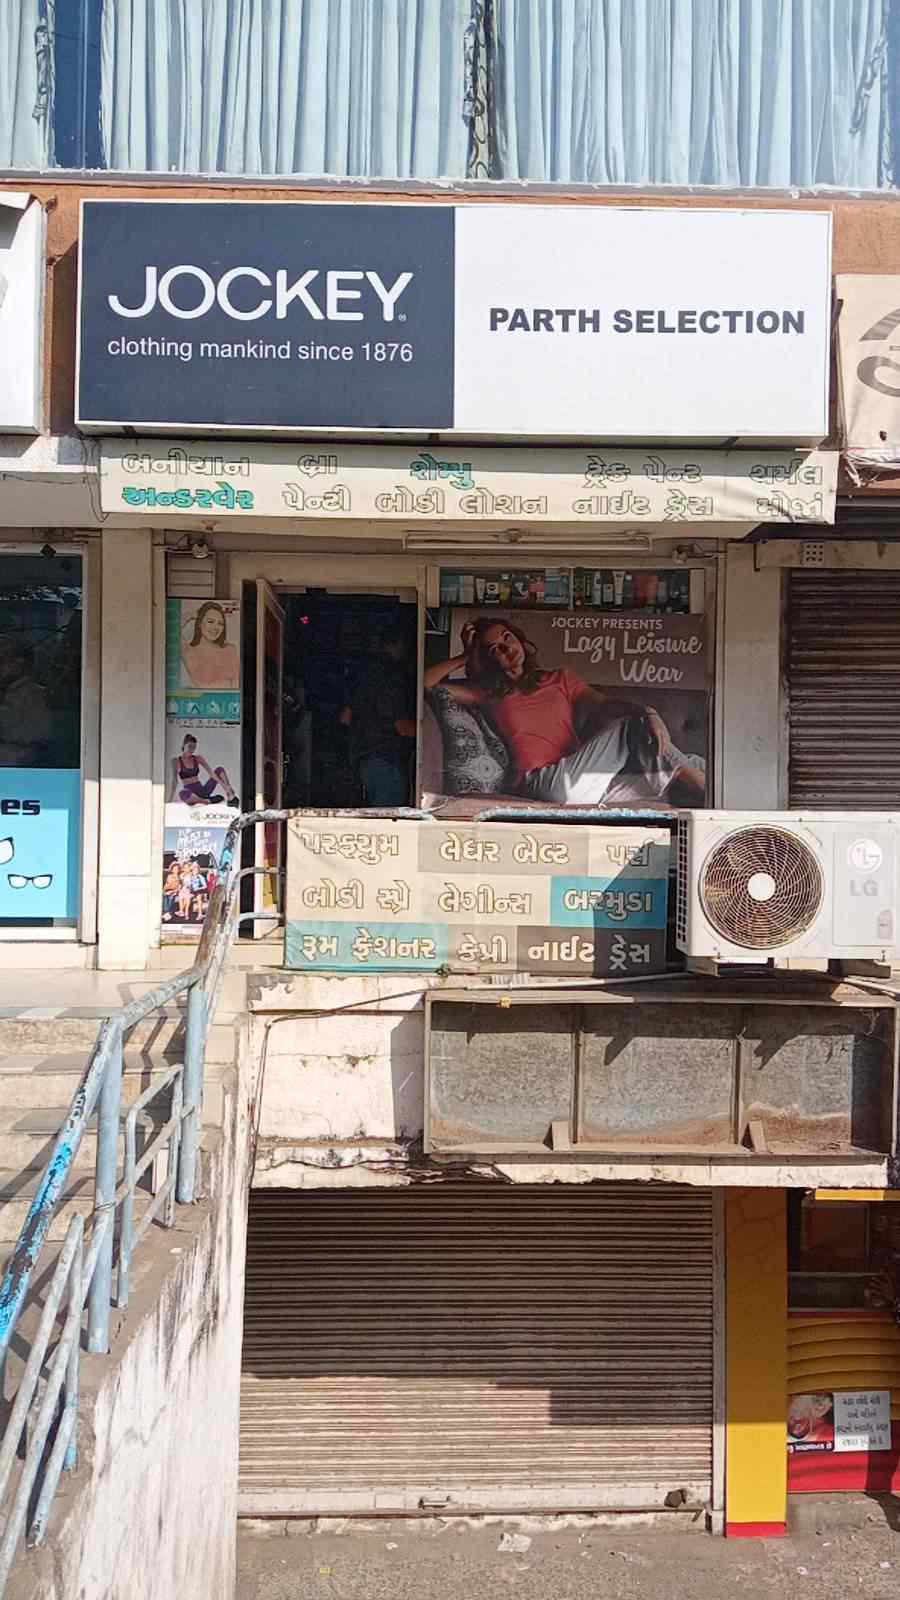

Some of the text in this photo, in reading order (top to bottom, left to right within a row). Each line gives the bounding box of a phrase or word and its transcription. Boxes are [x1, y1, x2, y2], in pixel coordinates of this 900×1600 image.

[108, 265, 413, 321] JOCKEY
[489, 308, 805, 334] PARTH SELECTION
[107, 336, 413, 362] clothing mankind since 1876
[375, 486, 446, 514] બોડી
[552, 617, 664, 630] JOCKEY PRESENTS
[564, 629, 702, 663] Lazy Leisure
[620, 658, 683, 682] Wear
[302, 877, 364, 909] બોડી
[849, 879, 879, 897] LG
